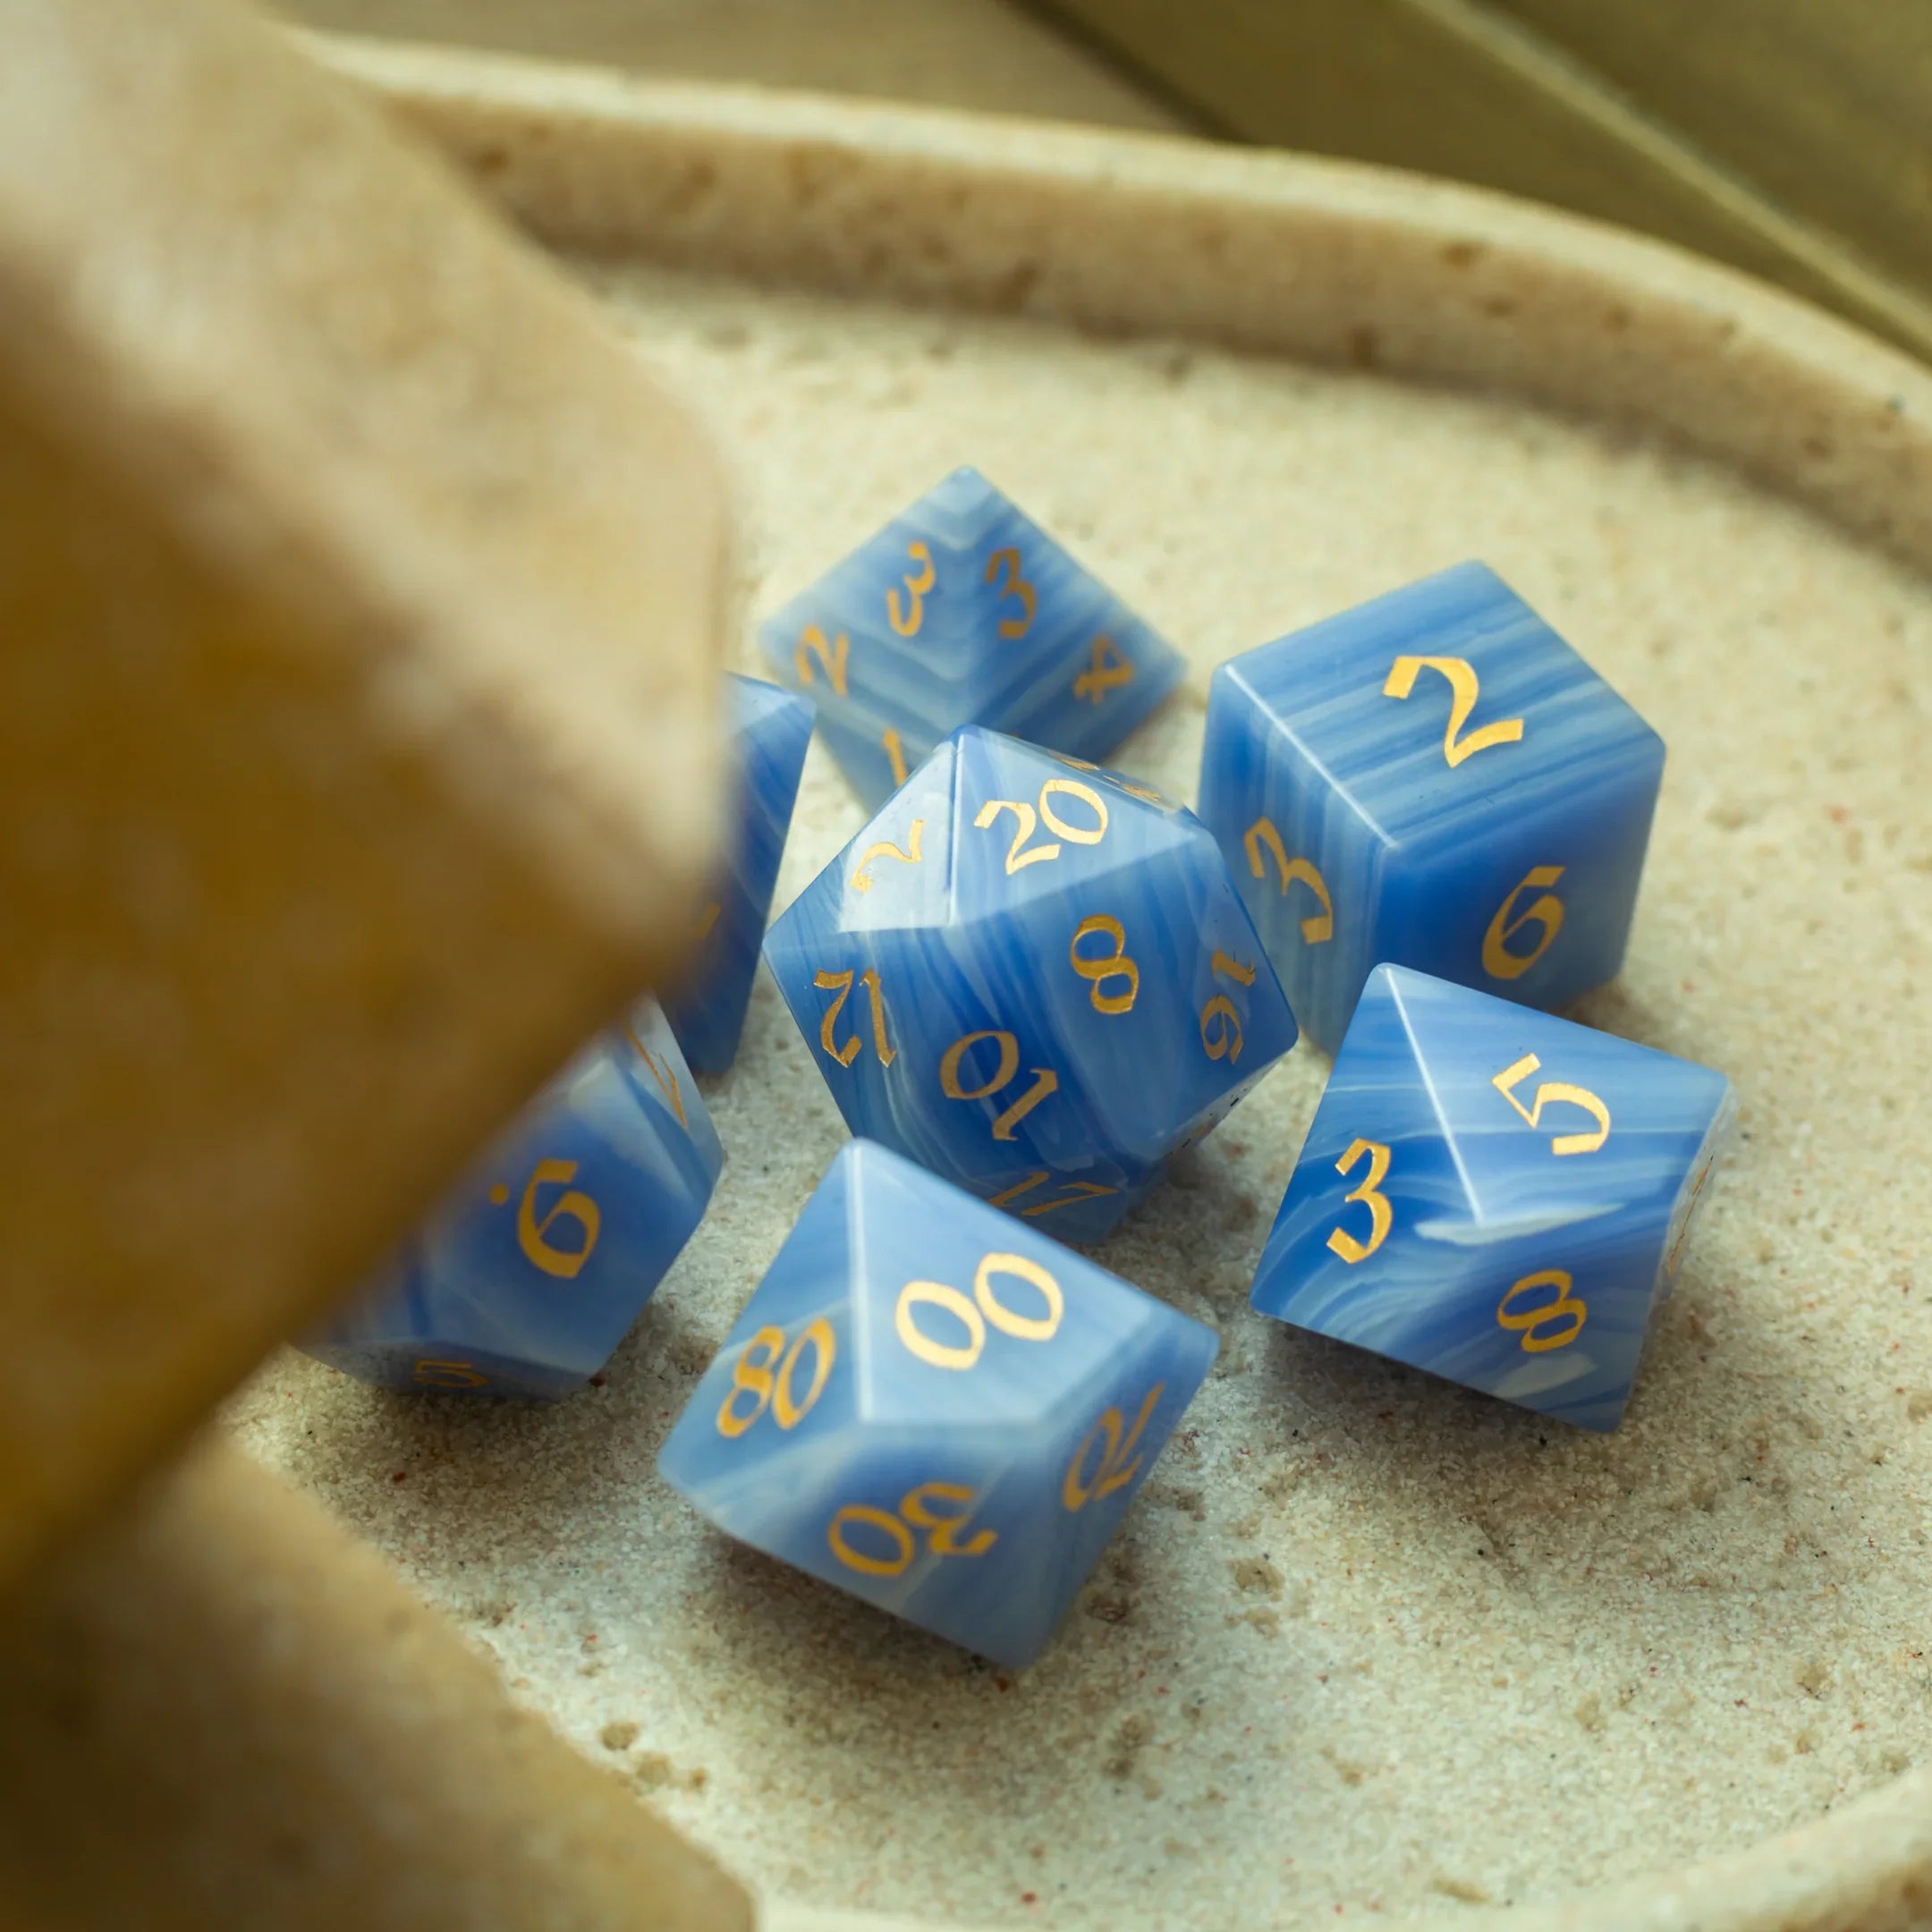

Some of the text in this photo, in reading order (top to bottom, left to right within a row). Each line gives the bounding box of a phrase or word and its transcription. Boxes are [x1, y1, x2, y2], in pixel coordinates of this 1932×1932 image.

[886, 541, 936, 637] 3
[985, 547, 1037, 639] 3
[794, 623, 849, 698] 2
[1074, 635, 1135, 705] 4
[1382, 656, 1524, 768] 2
[850, 819, 924, 893] 2
[973, 779, 1108, 875] 20
[1243, 817, 1333, 945] 3
[1481, 866, 1565, 979] 6
[1070, 914, 1139, 1014] 8
[1199, 948, 1256, 1064] 16
[813, 968, 897, 1068] 12
[939, 1030, 1058, 1141] 10
[1492, 1053, 1611, 1156] 5
[987, 1171, 1119, 1216] 17
[1326, 1138, 1393, 1265] 3
[894, 1251, 1063, 1370] 00
[1496, 1269, 1587, 1352] 8
[716, 1317, 835, 1439] 80
[1063, 1381, 1164, 1512] 70
[827, 1481, 998, 1576] 30
